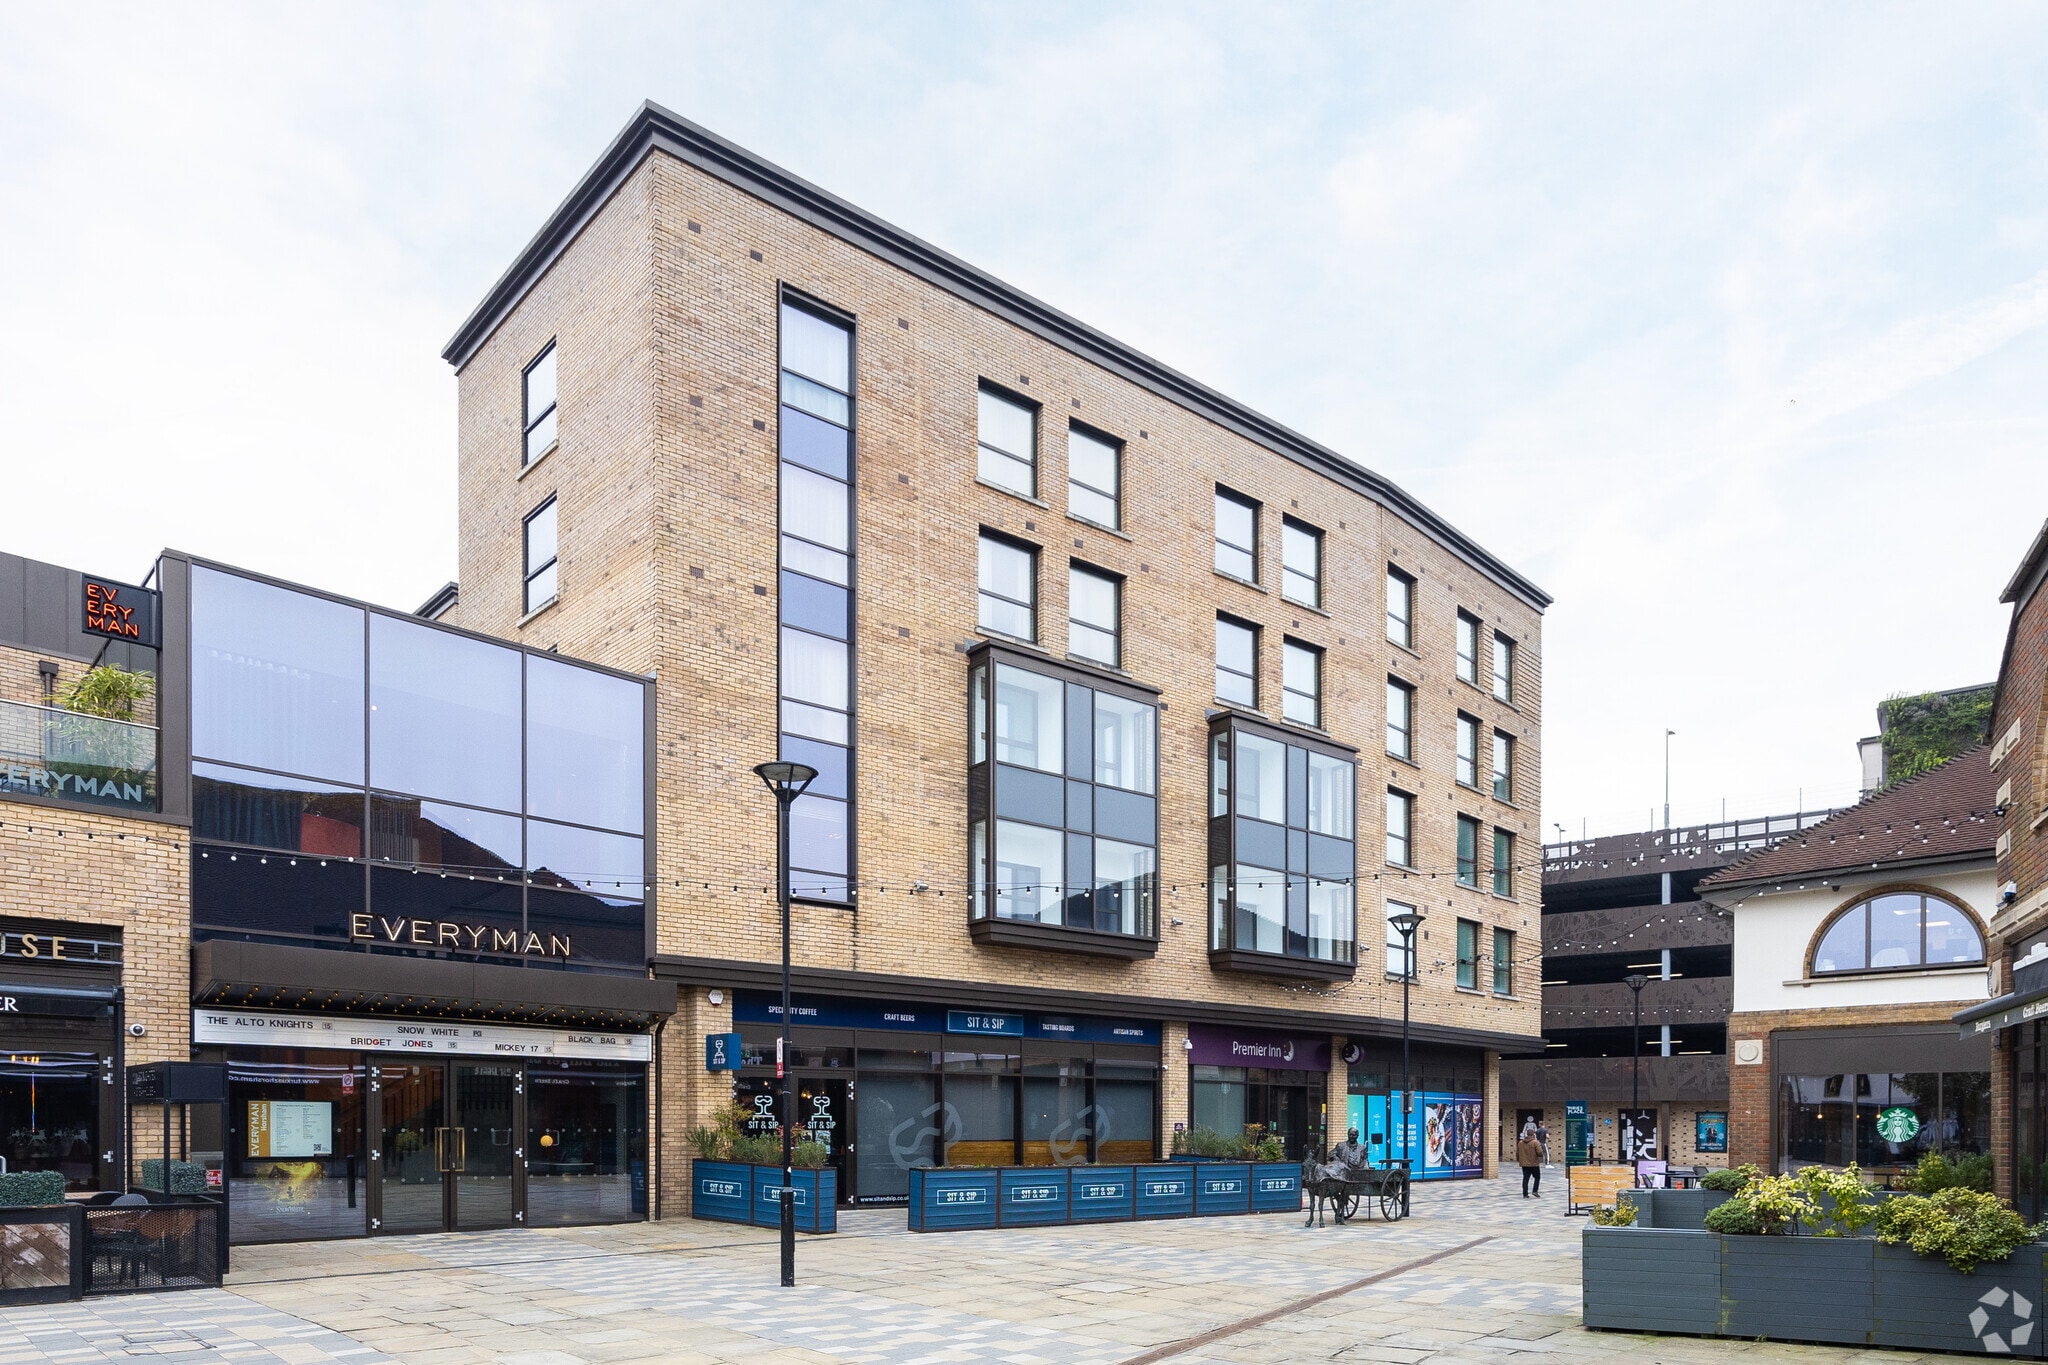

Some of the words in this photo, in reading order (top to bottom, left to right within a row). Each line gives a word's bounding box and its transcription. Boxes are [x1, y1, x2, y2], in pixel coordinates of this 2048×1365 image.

[87, 582, 117, 602] EV
[87, 600, 133, 621] ERY
[88, 616, 139, 638] MAN
[351, 912, 571, 957] EVERYMAN
[799, 1008, 817, 1016] COFFEE
[207, 1016, 228, 1025] THE
[235, 1018, 264, 1027] ALTO
[270, 1020, 314, 1029] KNIGHTS
[967, 1016, 980, 1028] SIT
[982, 1018, 990, 1028] &
[992, 1018, 1004, 1030] SIP
[398, 1026, 424, 1035] SNOW
[432, 1028, 459, 1036] WHITE
[350, 1037, 392, 1046] BRIDGET
[402, 1040, 433, 1048] JONES
[568, 1036, 594, 1044] BLACK
[600, 1036, 616, 1045] BAG
[494, 1044, 525, 1052] MICKEY
[1232, 1040, 1267, 1057] Premier
[1268, 1044, 1281, 1058] Inn
[251, 1104, 259, 1156] EVERYMAN
[748, 1121, 759, 1129] SIT
[760, 1121, 766, 1129] &
[768, 1121, 779, 1129] SIP
[808, 1121, 817, 1129] SIT
[819, 1121, 824, 1129] &
[826, 1121, 836, 1129] SIP
[710, 1183, 718, 1192] SIT
[725, 1185, 734, 1194] SIP
[1090, 1187, 1099, 1196] SIT
[1107, 1186, 1116, 1196] SIP
[1153, 1185, 1162, 1193] SIT
[1169, 1184, 1178, 1193] SIP
[947, 1192, 957, 1201] SIT
[959, 1192, 965, 1201] &
[966, 1192, 977, 1201] SIP
[1021, 1189, 1031, 1199] SIT
[1033, 1189, 1038, 1199] &
[1039, 1189, 1049, 1198] SIP
